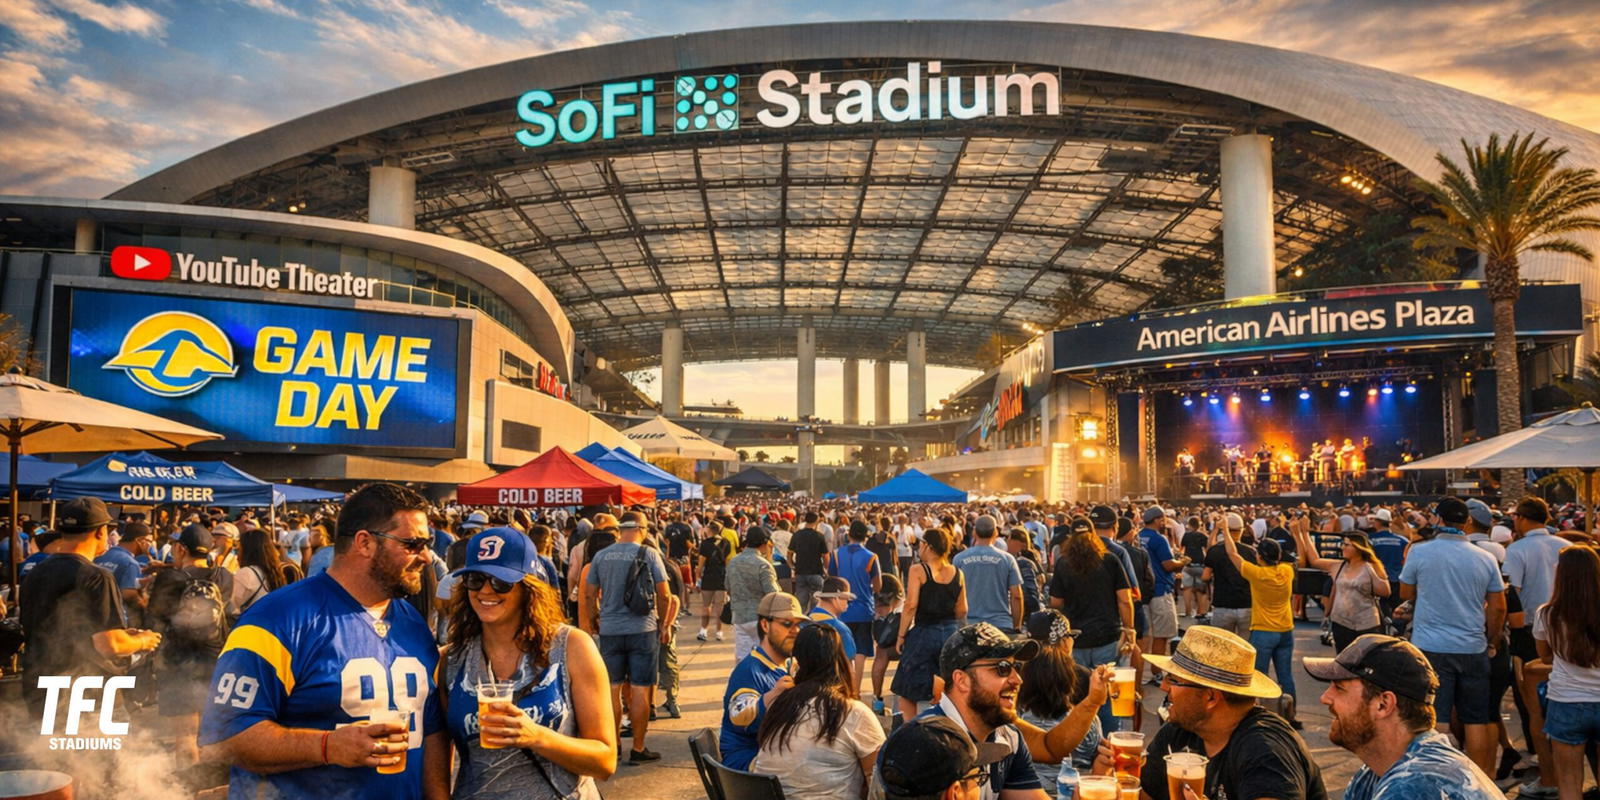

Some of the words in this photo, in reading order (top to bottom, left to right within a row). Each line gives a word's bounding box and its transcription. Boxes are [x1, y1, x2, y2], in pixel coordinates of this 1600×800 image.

[515, 79, 655, 147] SoFi
[756, 61, 1060, 128] Stadium
[177, 252, 281, 289] YouTube
[284, 262, 378, 298] Theater
[1137, 319, 1260, 351] American
[1265, 307, 1387, 338] Airlines
[1396, 300, 1475, 328] Plaza
[253, 326, 432, 383] GAME
[275, 380, 399, 430] DAY
[120, 485, 166, 501] COLD
[171, 487, 214, 502] BEER
[498, 488, 538, 504] COLD
[544, 488, 583, 503] BEER
[214, 673, 260, 709] 99
